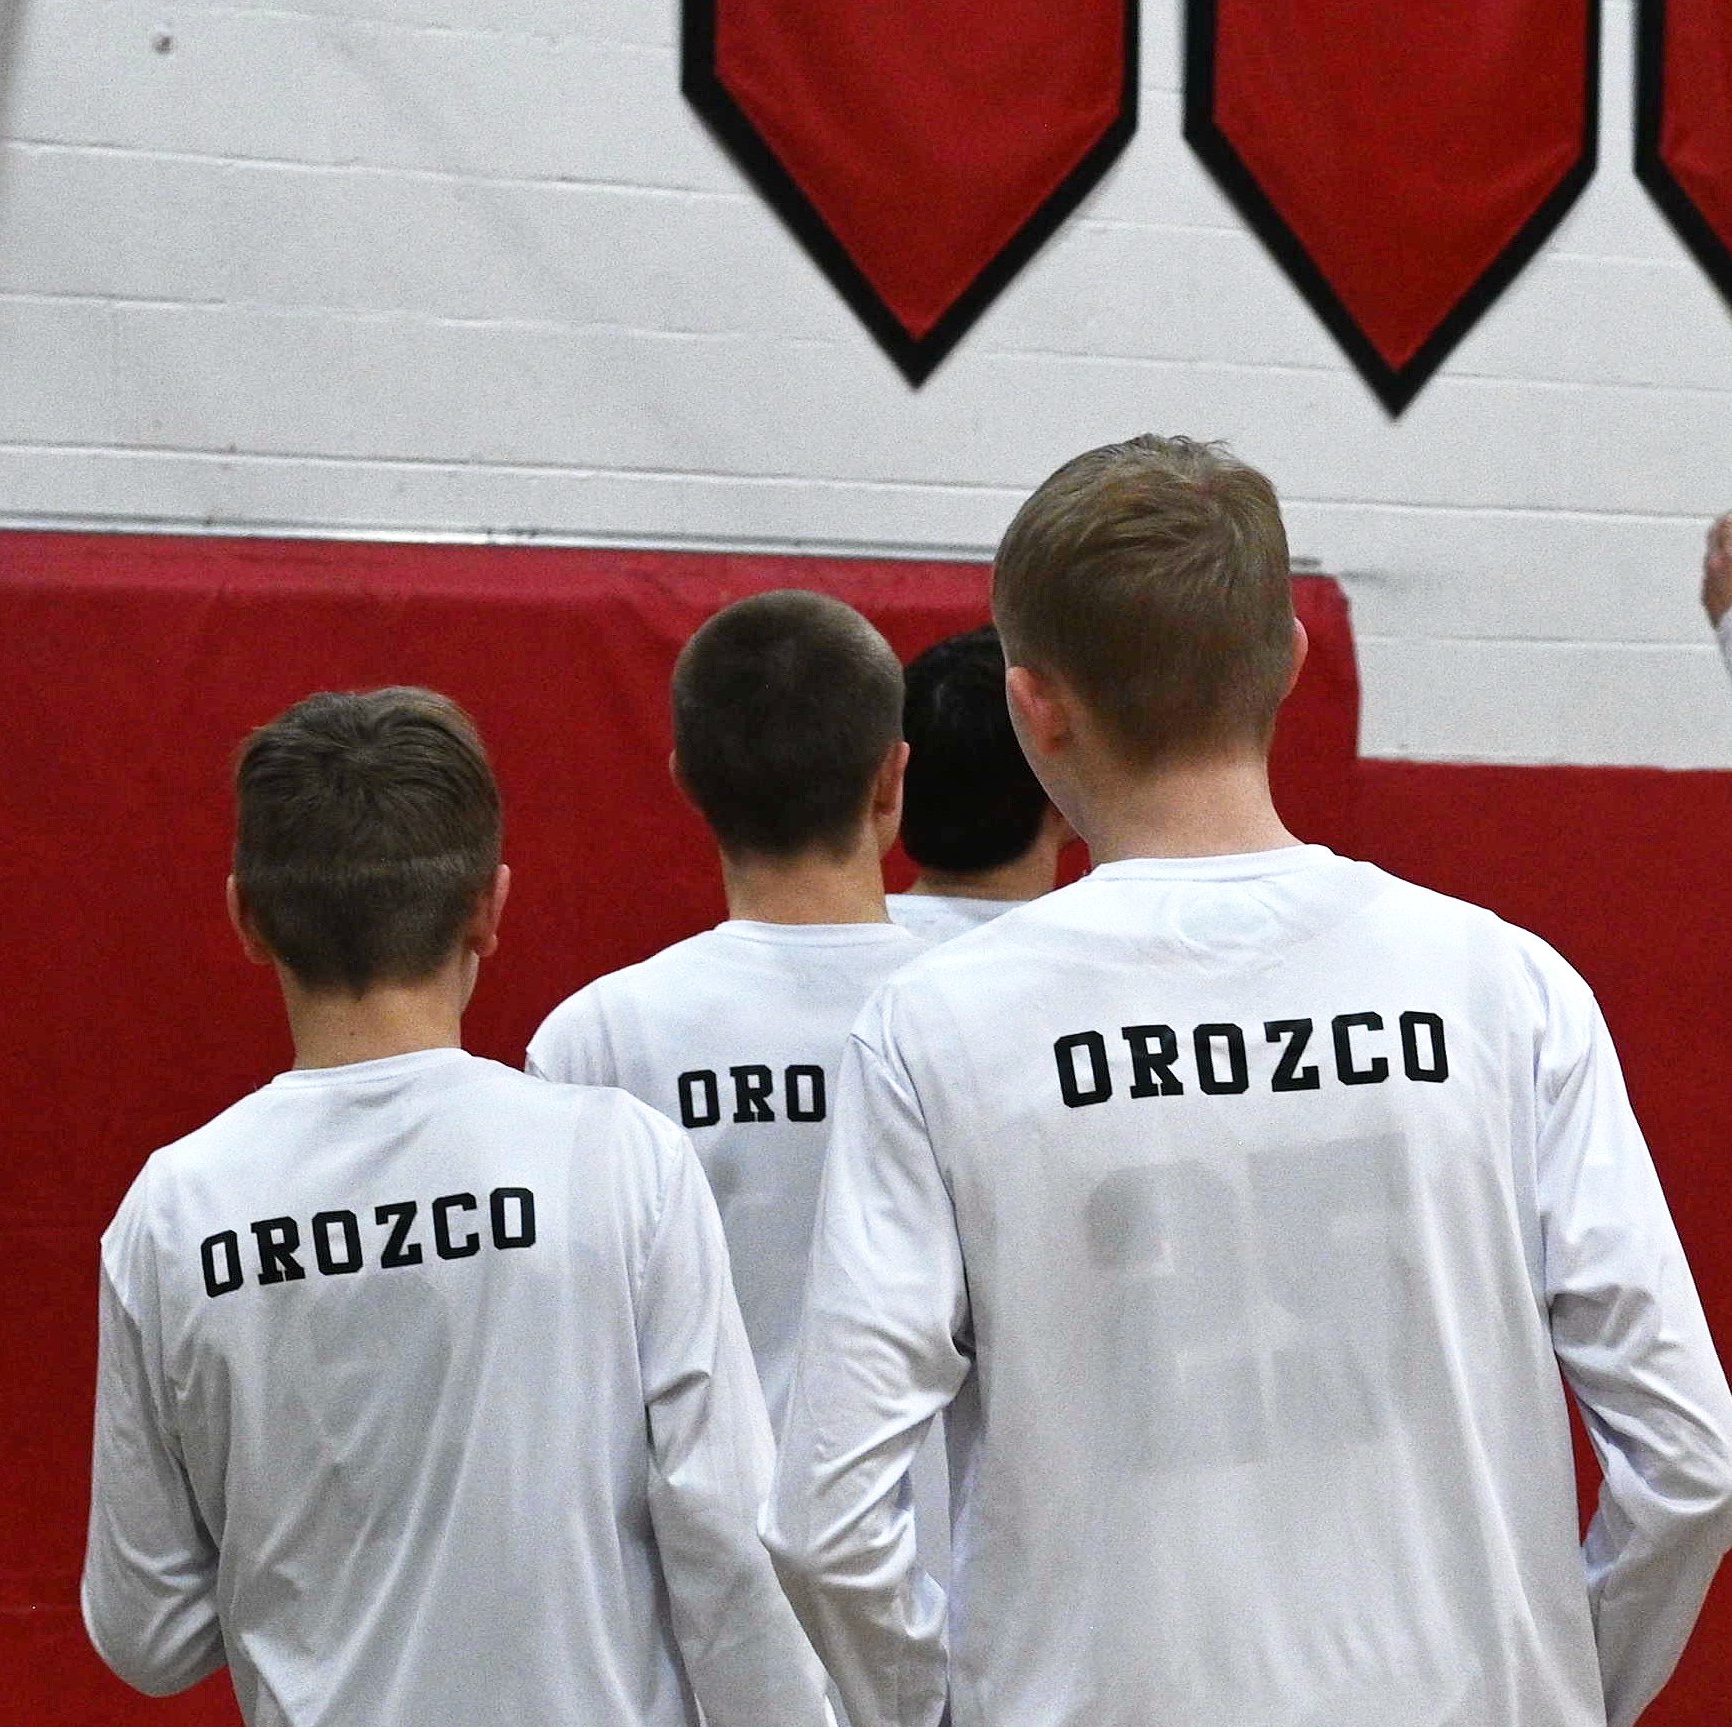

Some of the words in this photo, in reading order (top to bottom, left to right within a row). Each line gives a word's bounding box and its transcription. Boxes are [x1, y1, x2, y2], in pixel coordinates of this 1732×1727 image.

[677, 1064, 827, 1130] ORO
[1053, 1010, 1449, 1109] OROZCO
[200, 1187, 536, 1299] OROZCO
